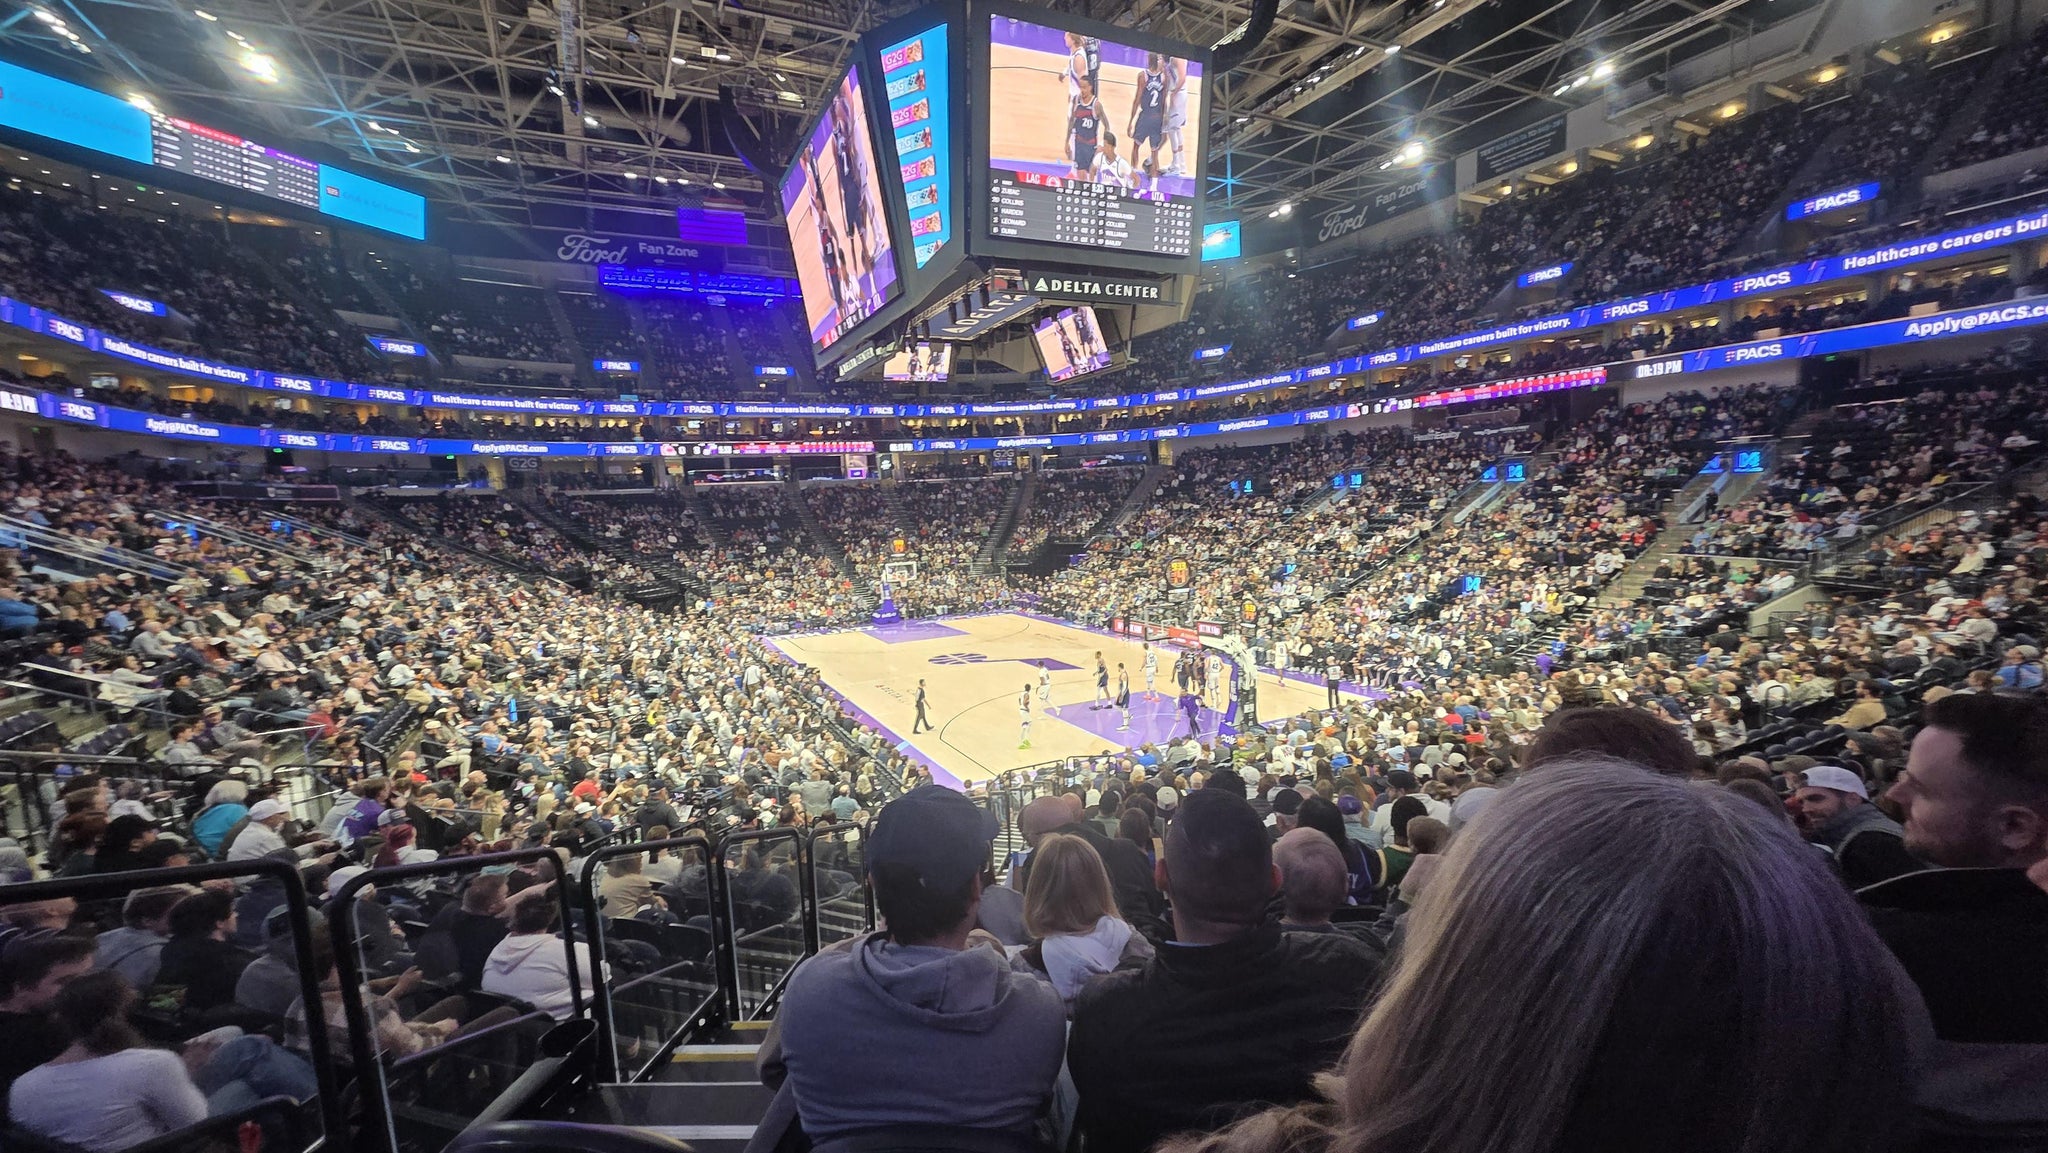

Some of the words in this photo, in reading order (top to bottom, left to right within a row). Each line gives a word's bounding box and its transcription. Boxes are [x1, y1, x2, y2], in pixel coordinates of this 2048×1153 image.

[886, 50, 902, 64] G2G
[892, 108, 910, 120] G2G
[1082, 118, 1094, 128] 20
[1376, 190, 1397, 208] Fan
[1398, 180, 1428, 198] Zone
[1001, 198, 1024, 206] COLLINS
[1813, 189, 1861, 212] PACS
[1318, 204, 1368, 242] Ford
[558, 234, 628, 264] Ford
[638, 242, 664, 256] Fan
[666, 245, 699, 258] Zone
[1843, 241, 1938, 270] Healthcare
[1942, 225, 2012, 250] careers
[1534, 266, 1562, 282] PACS
[1743, 271, 1792, 292] PACS
[1052, 279, 1102, 294] DELTA
[1105, 283, 1158, 300] CENTER
[120, 296, 154, 313] PACS
[956, 294, 1028, 326] DELTA
[1612, 300, 1649, 318] PACS
[1359, 314, 1378, 326] PACS
[57, 320, 85, 342] PACS
[1419, 341, 1462, 355] Healthcare
[1462, 334, 1494, 346] careers
[1495, 327, 1517, 340] built
[1518, 324, 1533, 335] for
[1534, 317, 1571, 332] victory.
[387, 343, 416, 354] PACS
[1204, 348, 1224, 358] PACS
[1736, 344, 1782, 361] PACS
[103, 338, 148, 360] Healthcare
[148, 352, 178, 368] careers
[179, 358, 200, 372] built
[200, 362, 214, 374] for
[214, 366, 248, 382] victory.
[1374, 352, 1397, 364] PACS
[607, 362, 631, 370] PACS
[767, 366, 787, 375] PACS
[1312, 366, 1330, 377] PACS
[1666, 360, 1683, 374] PM
[281, 378, 312, 391] PACS
[376, 389, 406, 401] PACS
[1159, 392, 1178, 402] PACS
[1196, 387, 1227, 396] Healthcare
[432, 394, 480, 406] Healthcare
[482, 399, 514, 408] careers
[515, 400, 534, 408] built
[535, 401, 548, 409] for
[548, 402, 580, 412] victory.
[1098, 398, 1118, 406] PACS
[68, 402, 96, 420] PACS
[610, 404, 636, 413] PACS
[689, 405, 714, 414] PACS
[735, 405, 773, 414] Healthcare
[800, 406, 815, 414] built
[816, 406, 826, 414] for
[1310, 410, 1328, 420] PACS
[146, 418, 220, 437] Apply@PACS.com
[1218, 419, 1268, 432] Apply@PACS.com
[1097, 433, 1118, 442] PACS
[1158, 428, 1178, 438] PACS
[287, 434, 318, 446] PACS
[379, 440, 410, 451] PACS
[472, 444, 548, 454] Apply@PACS.com
[611, 446, 638, 454] PACS
[993, 450, 1014, 458] G2G
[509, 458, 538, 468] G2G
